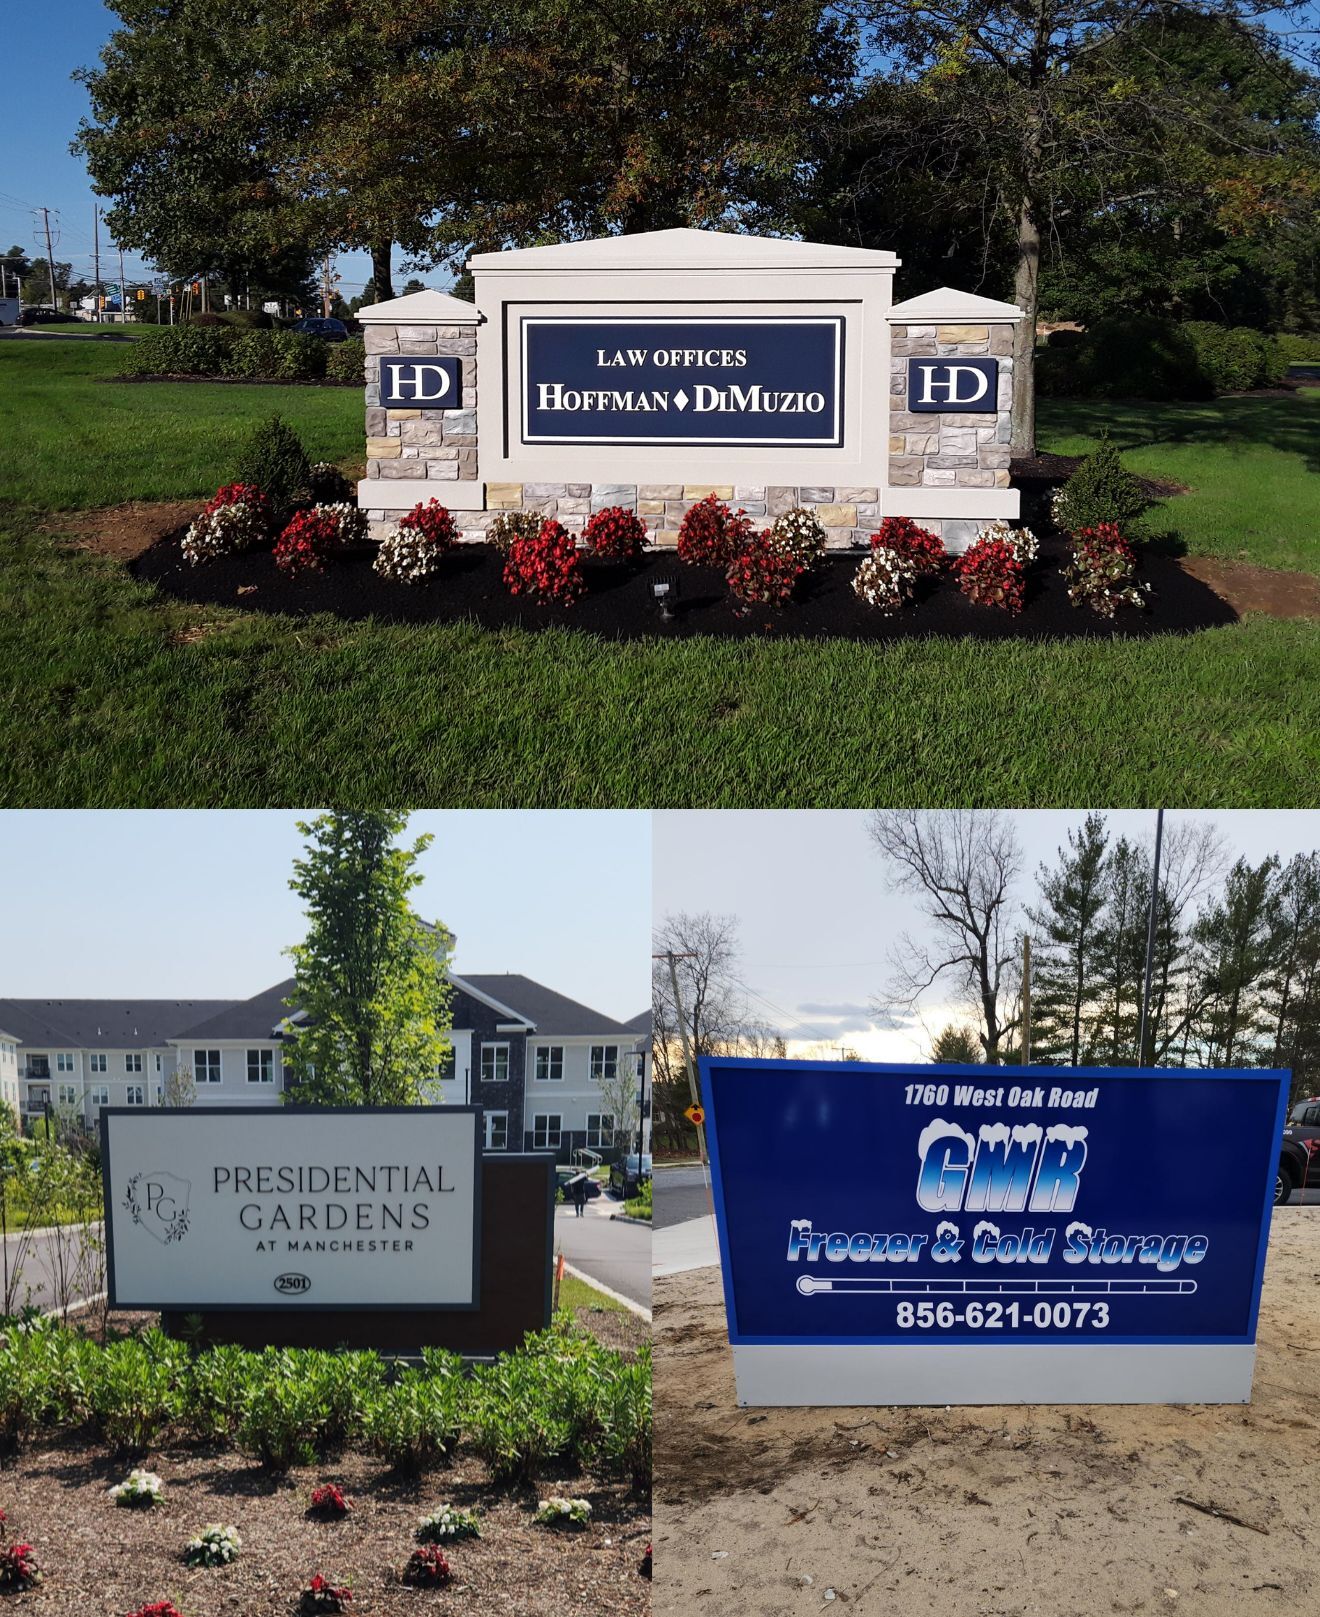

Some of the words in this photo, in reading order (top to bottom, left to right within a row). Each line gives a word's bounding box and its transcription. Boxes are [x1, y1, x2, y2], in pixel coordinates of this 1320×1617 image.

[597, 350, 647, 366] LAW
[653, 350, 747, 366] OFFICES
[387, 365, 450, 399] HD
[918, 366, 988, 403] HD
[536, 384, 669, 412] HOFFMAN
[905, 1084, 949, 1105] 1760
[954, 1085, 1004, 1106] West
[1007, 1086, 1046, 1107] Oak
[1047, 1087, 1099, 1108] Road
[916, 1118, 1089, 1213] GMR
[213, 1166, 455, 1193] PRESIDENTIAL
[240, 1204, 430, 1230] GARDENS
[256, 1240, 277, 1252] AT
[288, 1240, 414, 1252] MANCHESTER
[787, 1219, 928, 1263] Freezer
[931, 1220, 965, 1264] &
[971, 1220, 1057, 1265] Cold
[1062, 1221, 1209, 1272] Storage
[278, 1277, 307, 1290] 2501
[896, 1302, 1110, 1329] 856-621-0073
